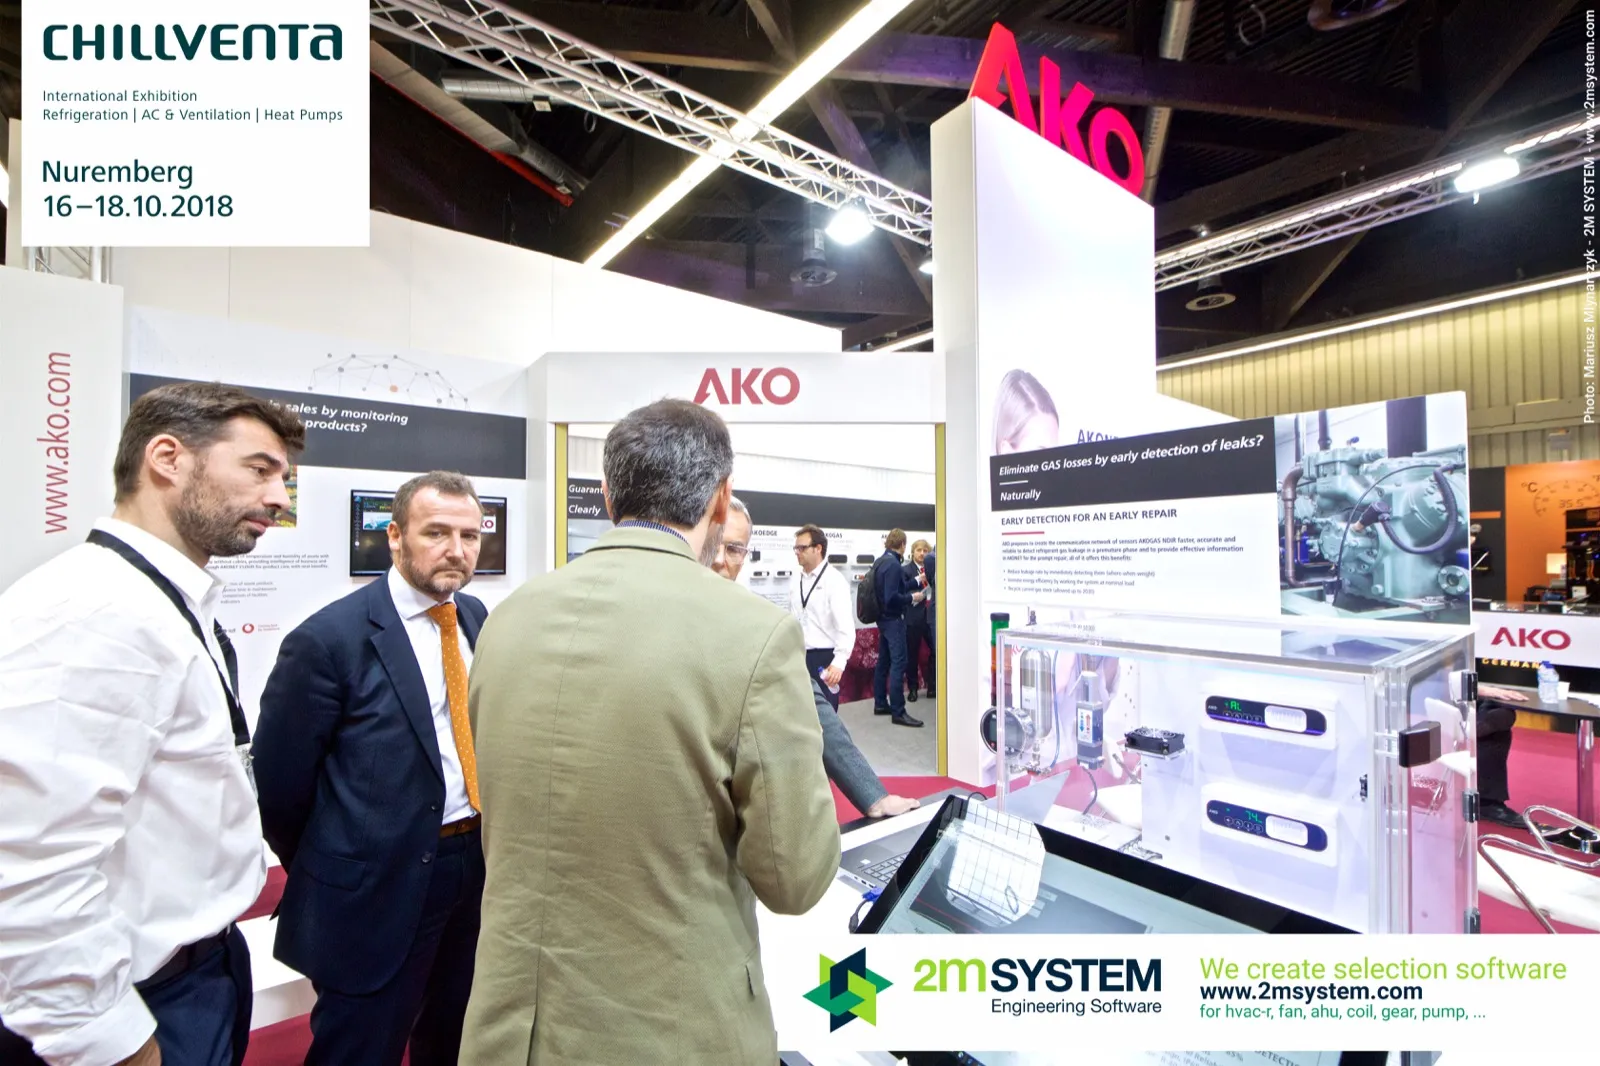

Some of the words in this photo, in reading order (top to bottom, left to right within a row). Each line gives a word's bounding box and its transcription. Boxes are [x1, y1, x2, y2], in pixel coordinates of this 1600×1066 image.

[967, 22, 1145, 197] AKO
[693, 366, 801, 405] AKO
[285, 403, 318, 414] sales
[322, 405, 338, 418] by
[341, 410, 409, 425] monitoring
[304, 419, 368, 433] products?
[36, 352, 71, 534] www.ako.com
[999, 464, 1039, 476] Eliminate
[1041, 460, 1061, 471] GAS
[1063, 458, 1092, 469] losses
[1094, 454, 1109, 467] by
[1110, 450, 1139, 464] early
[1141, 445, 1199, 460] detection
[1202, 439, 1218, 453] of
[1220, 434, 1265, 451] leaks?
[1000, 488, 1042, 501] Naturally
[568, 504, 602, 516] Clearly
[1001, 517, 1024, 526] EARLY
[1026, 514, 1071, 525] DETECTION
[1073, 513, 1091, 523] FOR
[1093, 512, 1107, 522] AN
[1109, 511, 1139, 520] EARLY
[1141, 509, 1178, 519] REPAIR
[1491, 627, 1572, 651] AKO
